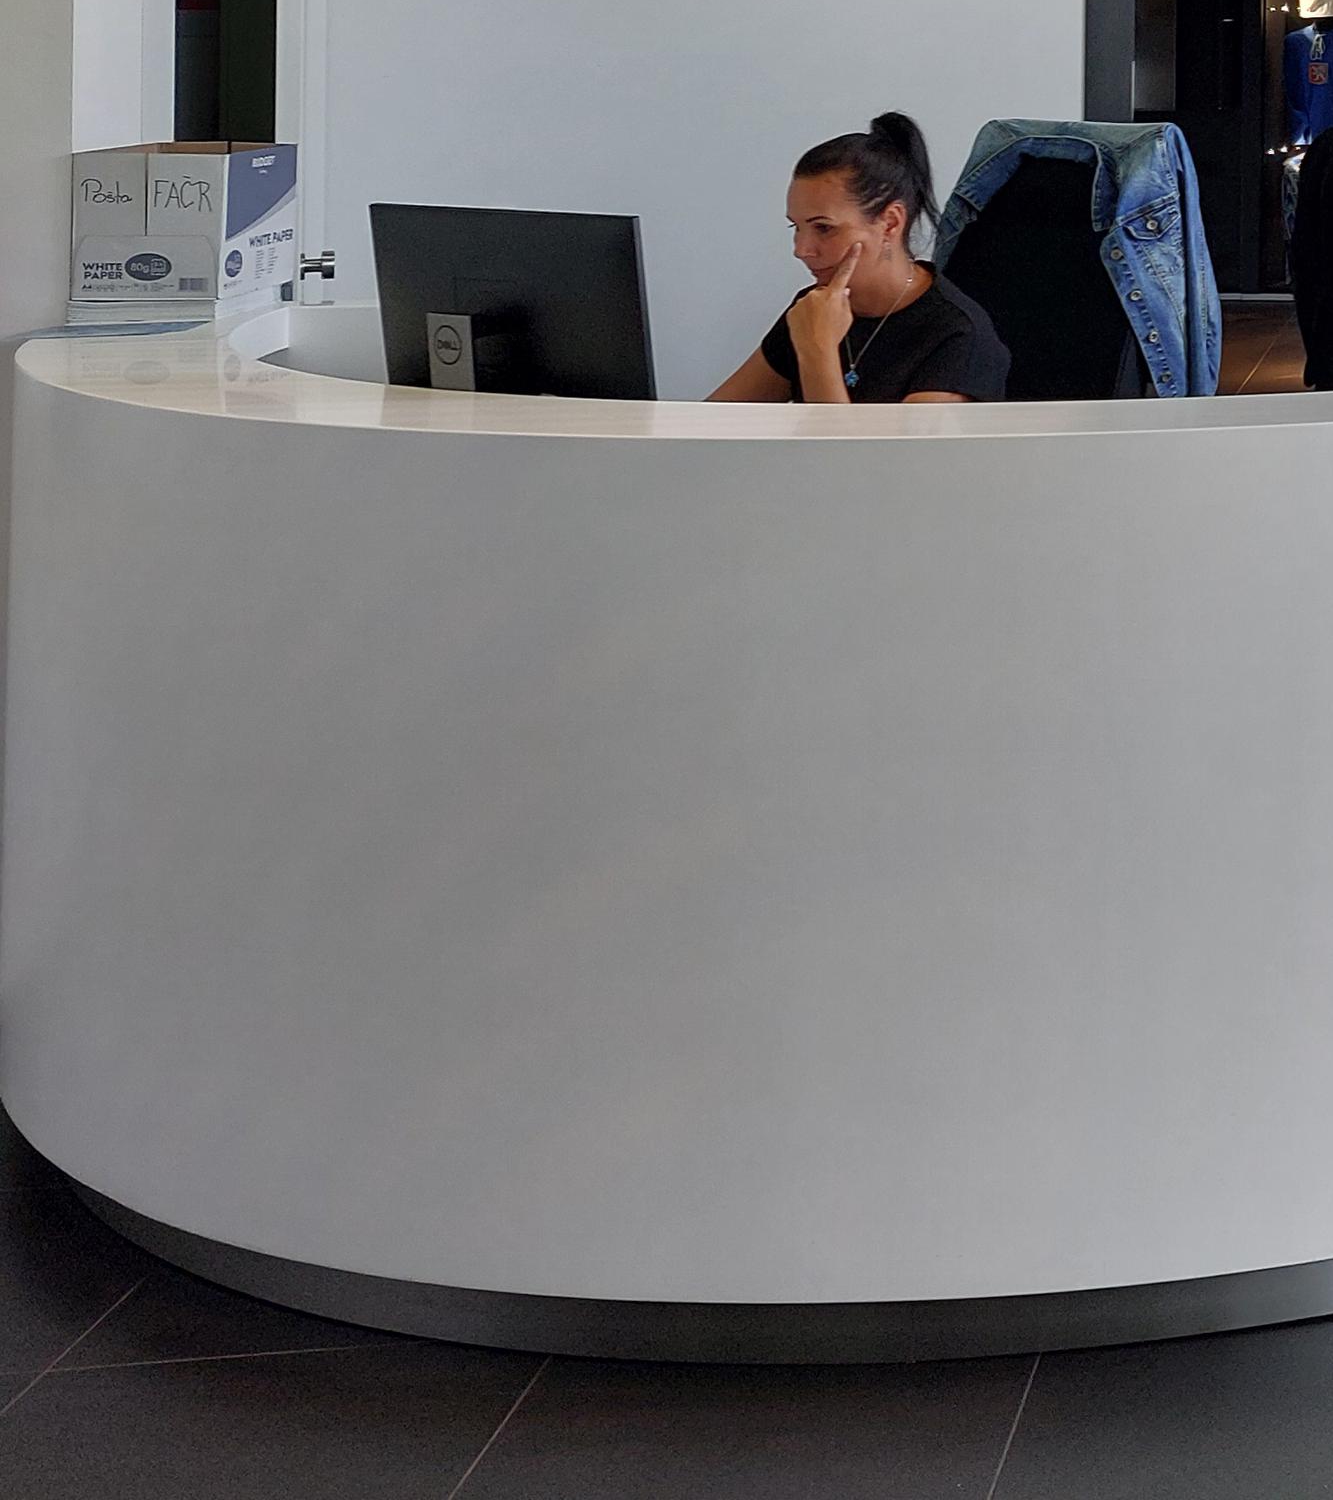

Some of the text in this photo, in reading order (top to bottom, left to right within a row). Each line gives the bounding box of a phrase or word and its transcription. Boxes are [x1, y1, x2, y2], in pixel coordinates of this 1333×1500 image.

[80, 175, 212, 212] Pošta FAČR
[82, 262, 123, 272] WHITE
[83, 271, 123, 280] PAPER
